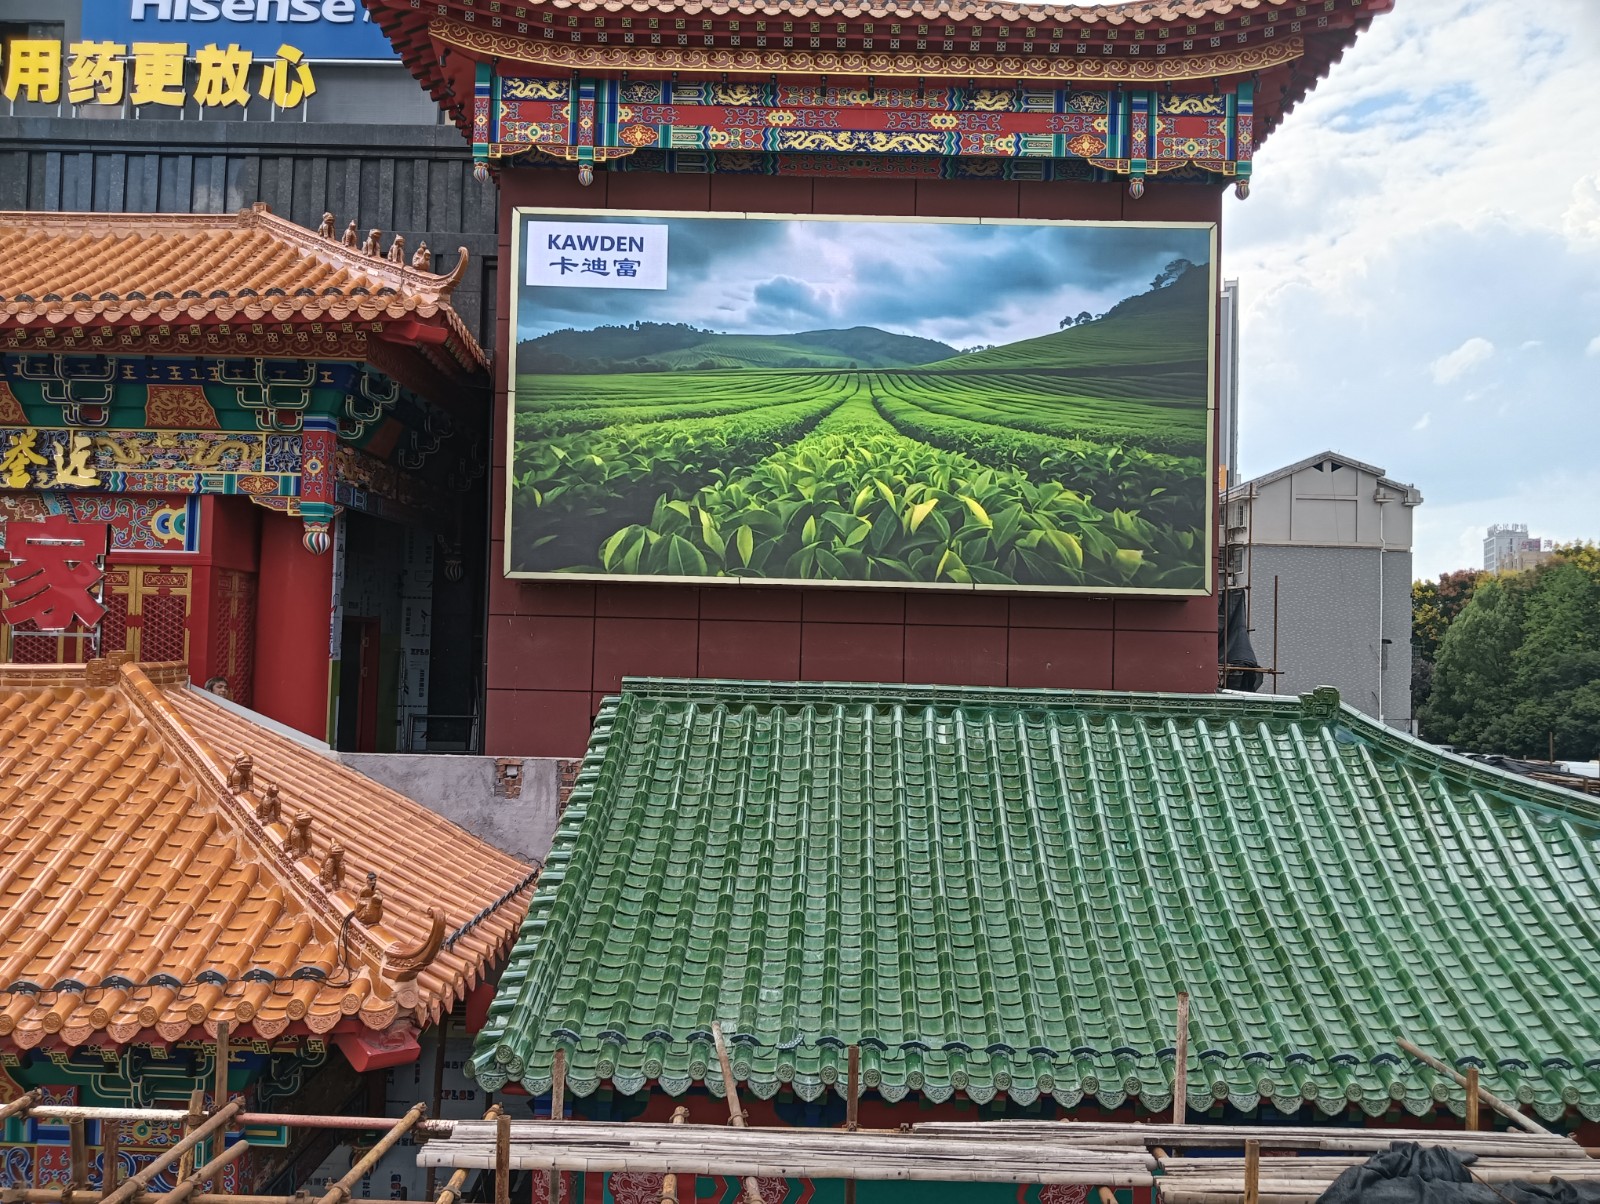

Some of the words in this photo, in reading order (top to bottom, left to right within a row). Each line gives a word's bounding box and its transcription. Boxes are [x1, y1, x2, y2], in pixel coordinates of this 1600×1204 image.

[4, 40, 318, 109] 用药更放心
[548, 234, 644, 253] KAWDEN
[549, 256, 641, 278] 卡迪富
